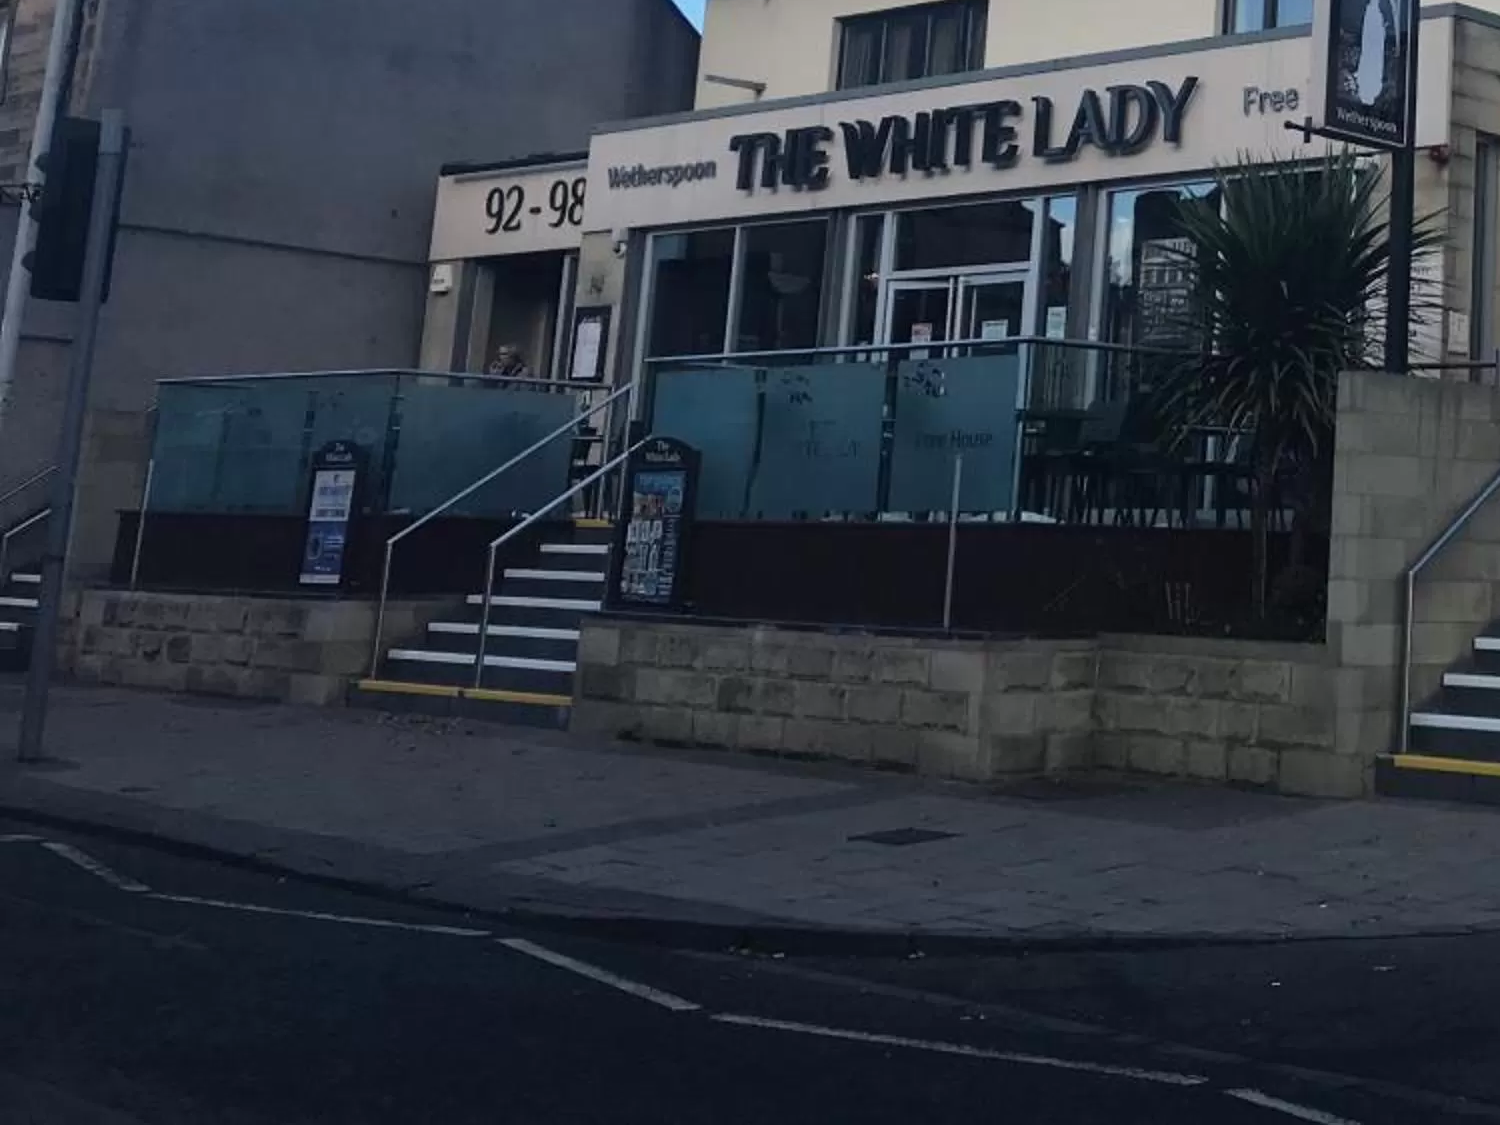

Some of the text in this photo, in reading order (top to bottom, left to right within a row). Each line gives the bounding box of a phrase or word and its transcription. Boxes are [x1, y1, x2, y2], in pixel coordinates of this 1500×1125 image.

[608, 76, 1299, 192] Wetherspoon THE WHITE LADY Free
[1336, 106, 1398, 133] Wetherspoon
